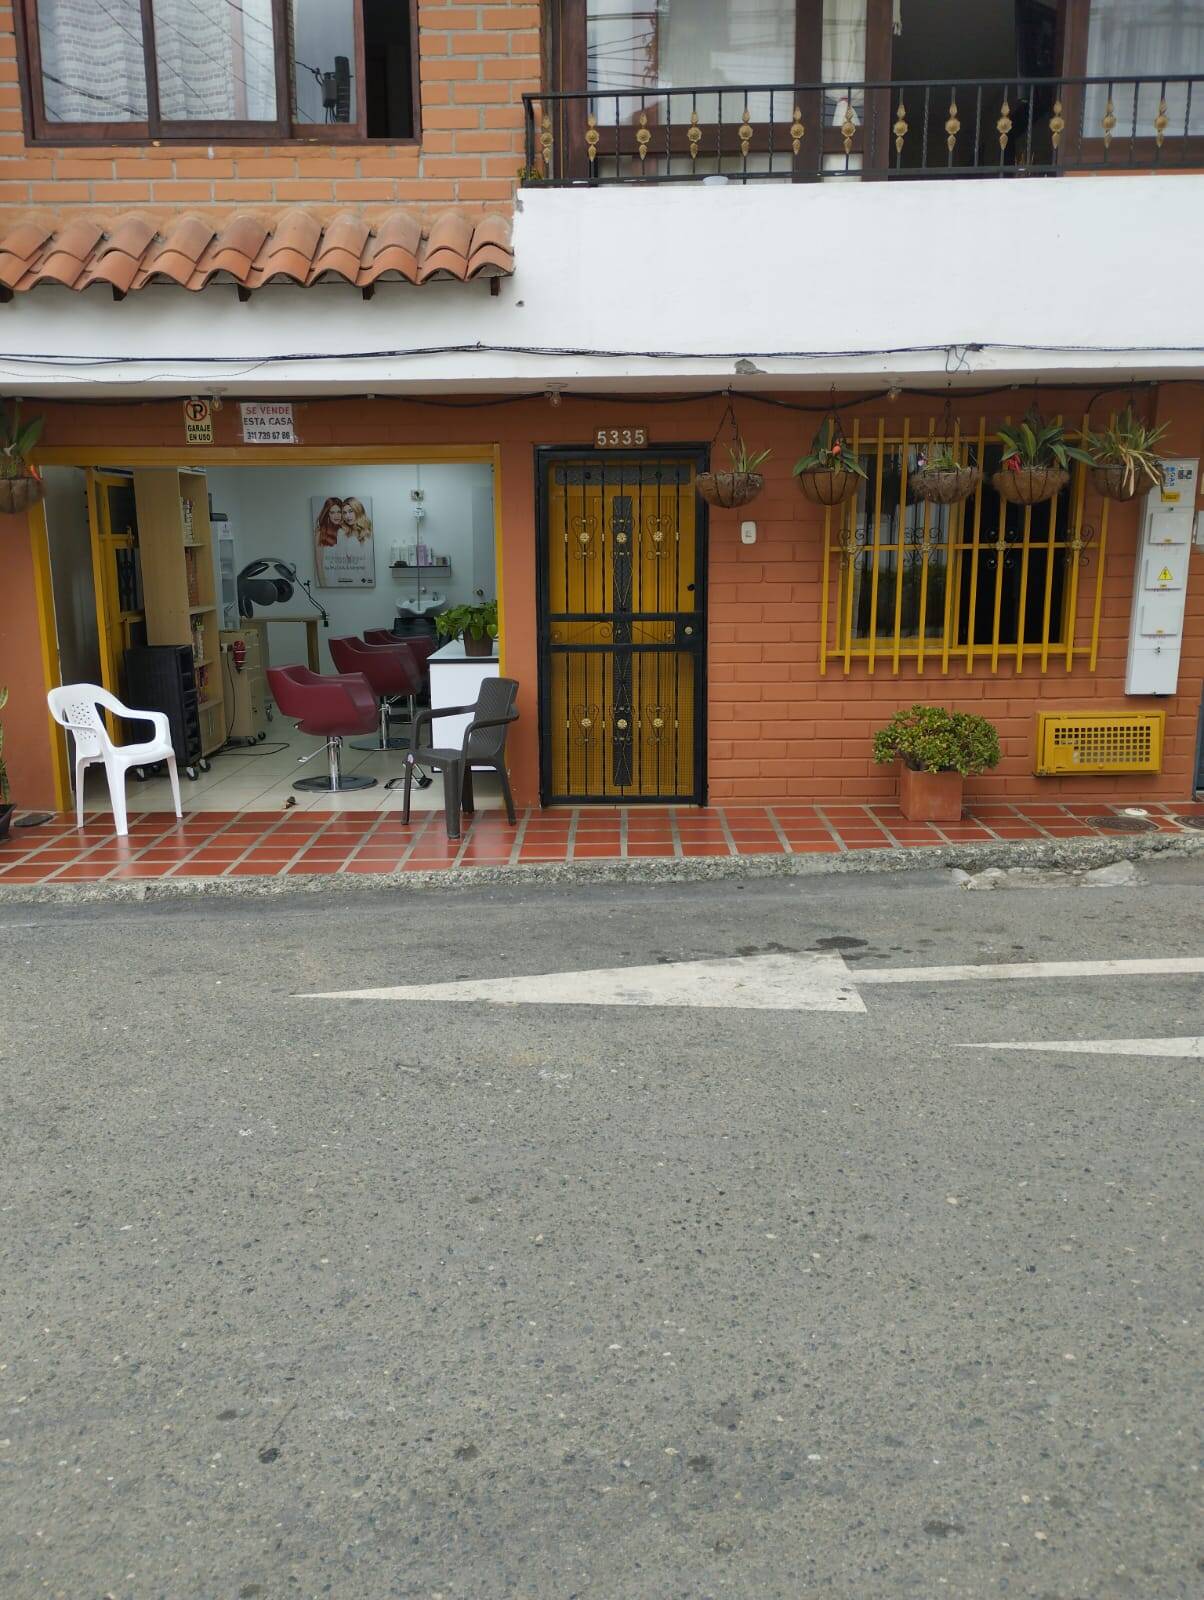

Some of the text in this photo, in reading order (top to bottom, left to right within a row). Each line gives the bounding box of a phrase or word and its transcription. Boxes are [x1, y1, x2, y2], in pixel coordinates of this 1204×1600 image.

[246, 406, 289, 415] SE VENDE
[243, 417, 293, 426] ESTA CASA
[187, 424, 211, 432] GARAJE
[189, 433, 211, 441] EN USO
[597, 430, 645, 446] 5335
